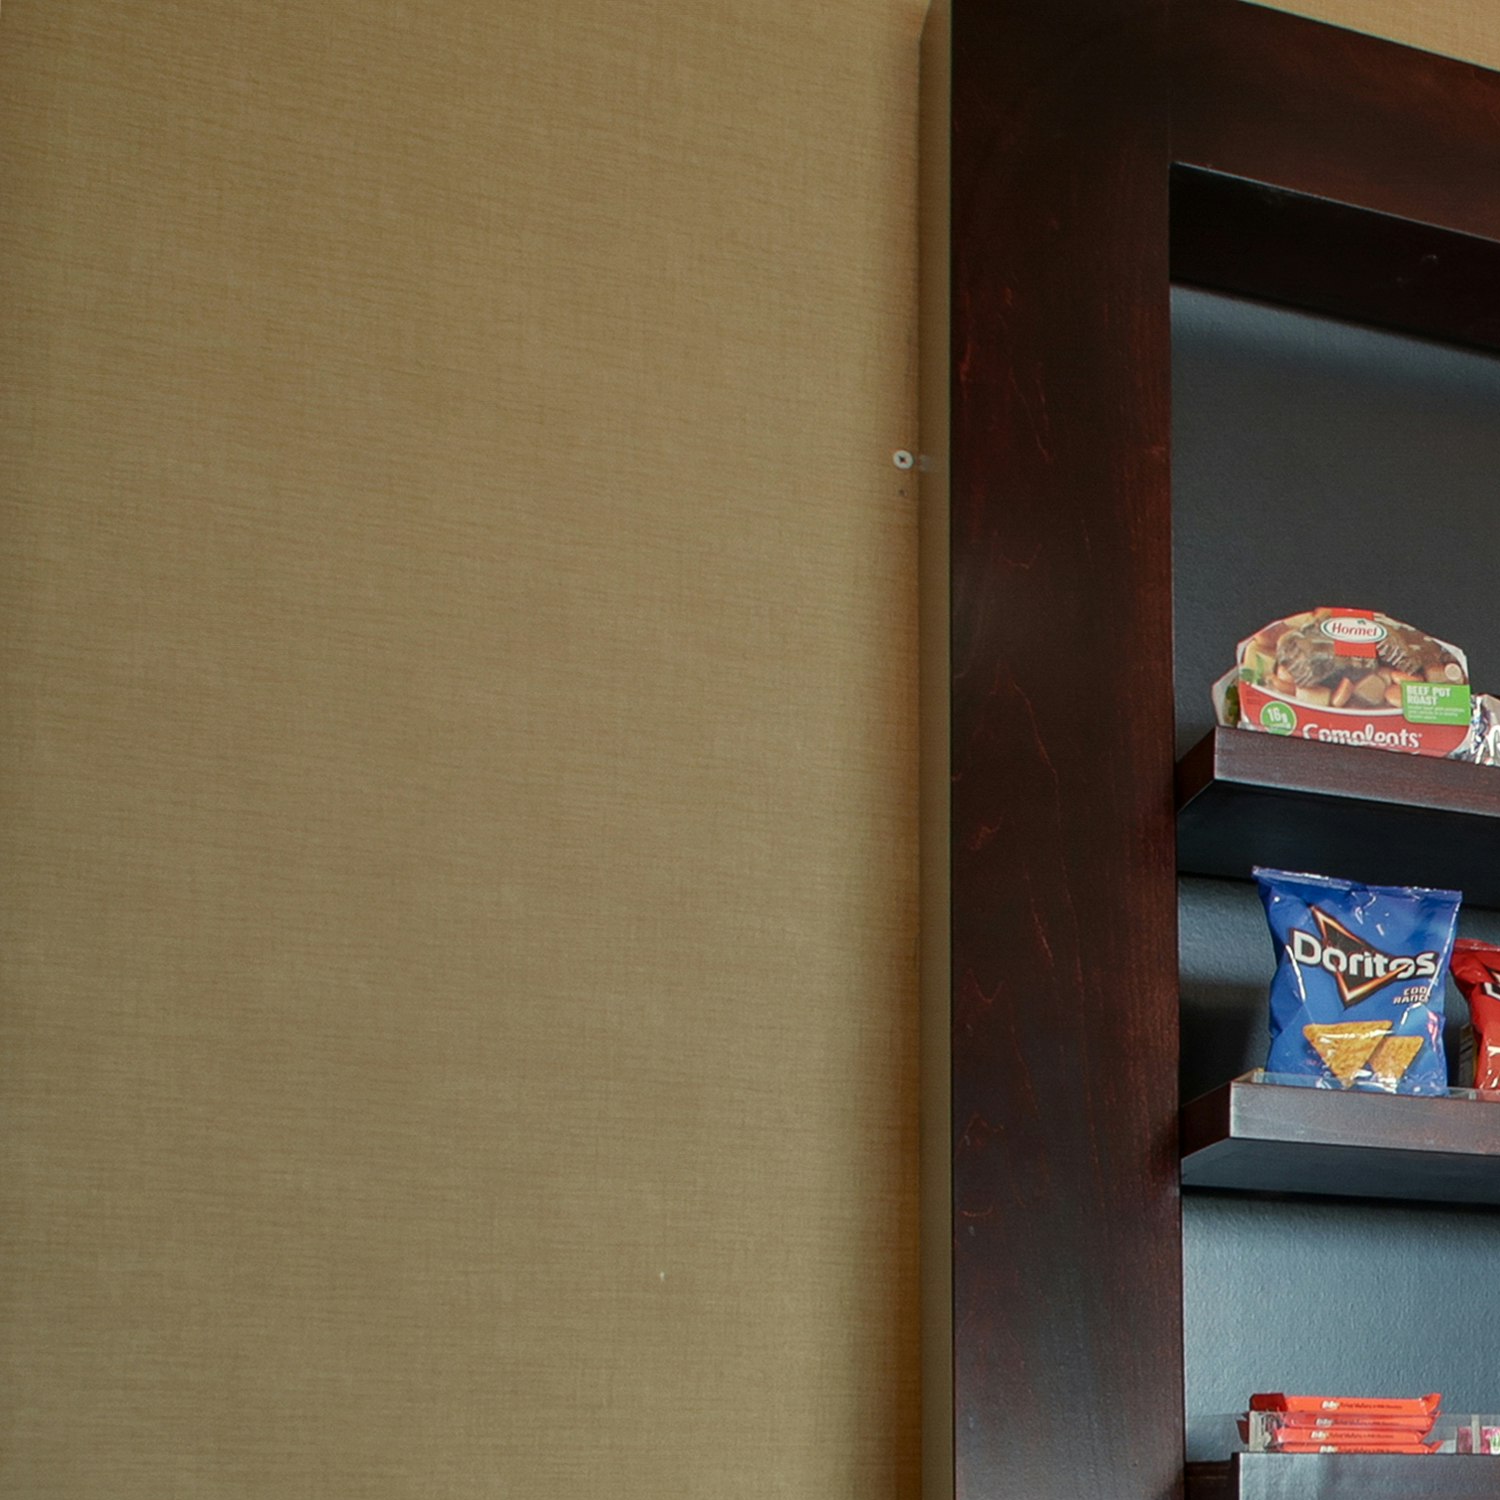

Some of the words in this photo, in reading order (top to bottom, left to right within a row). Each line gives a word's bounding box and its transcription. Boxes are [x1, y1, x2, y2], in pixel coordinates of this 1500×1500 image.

[1331, 621, 1378, 637] Hormel
[1432, 687, 1451, 698] POT
[1293, 929, 1438, 979] Doritos
